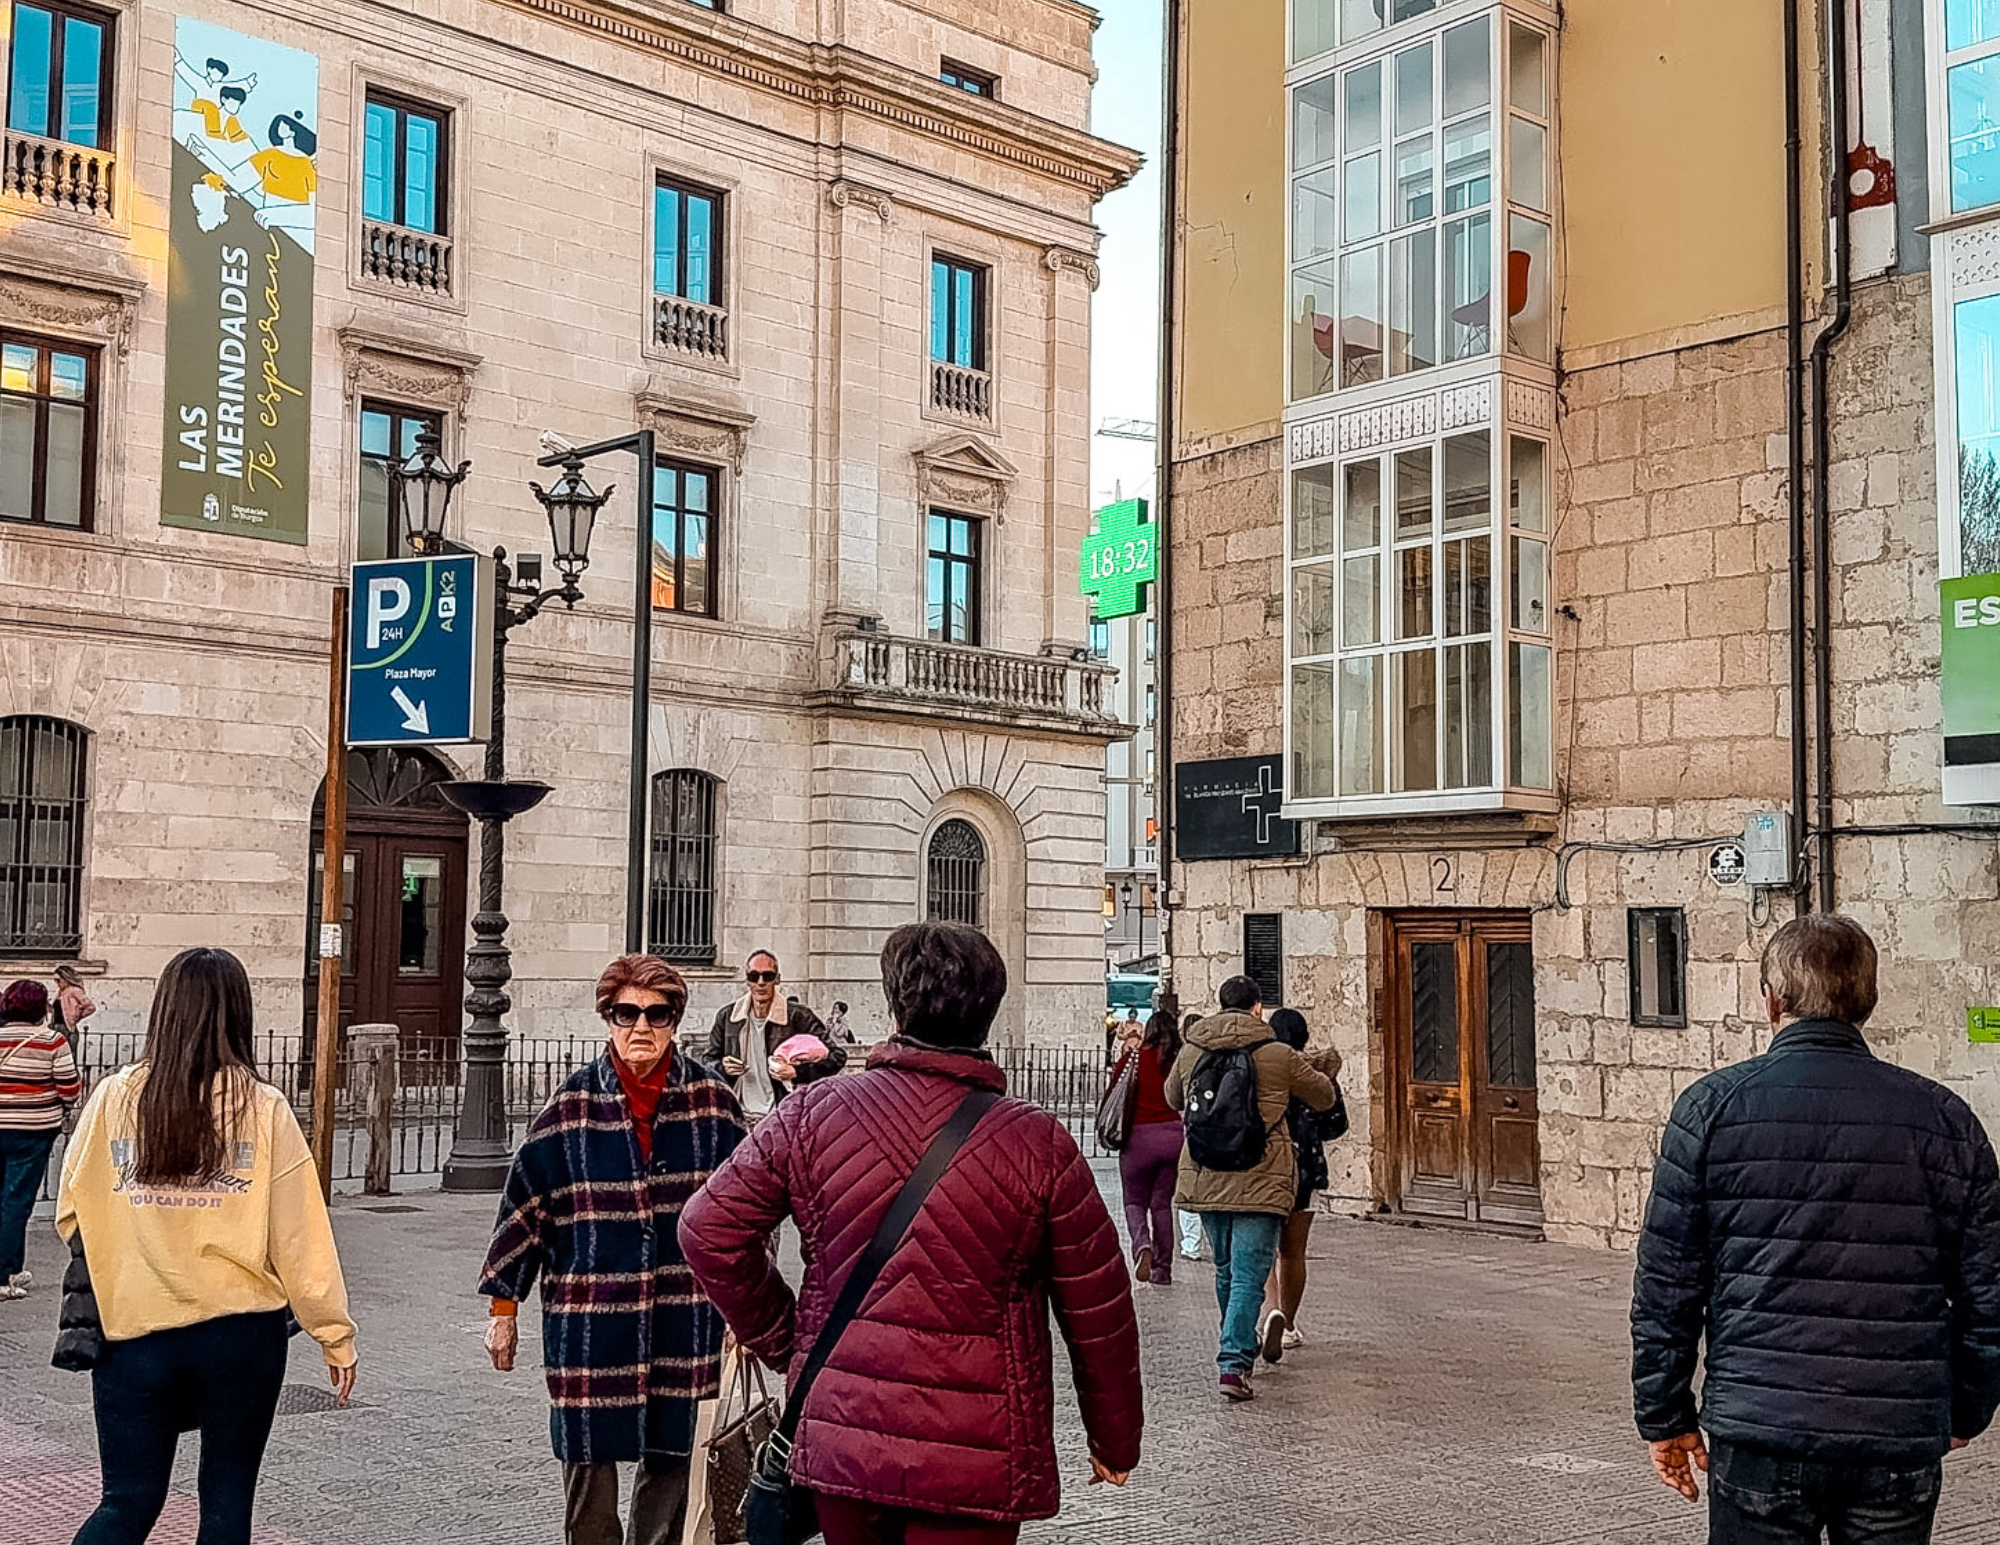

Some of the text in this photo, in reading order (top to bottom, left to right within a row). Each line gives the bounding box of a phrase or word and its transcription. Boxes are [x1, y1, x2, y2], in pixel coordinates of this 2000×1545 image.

[215, 244, 250, 479] MERINDADES
[247, 232, 304, 492] Te esperan
[178, 405, 208, 473] LAS
[1089, 539, 1149, 580] 18:32
[366, 577, 411, 649] P
[381, 627, 404, 641] 24H
[385, 668, 437, 681] Plaza Mayor
[1432, 857, 1454, 891] 2
[156, 1196, 181, 1206] CAN
[187, 1198, 207, 1207] DO
[210, 1198, 223, 1208] IT
